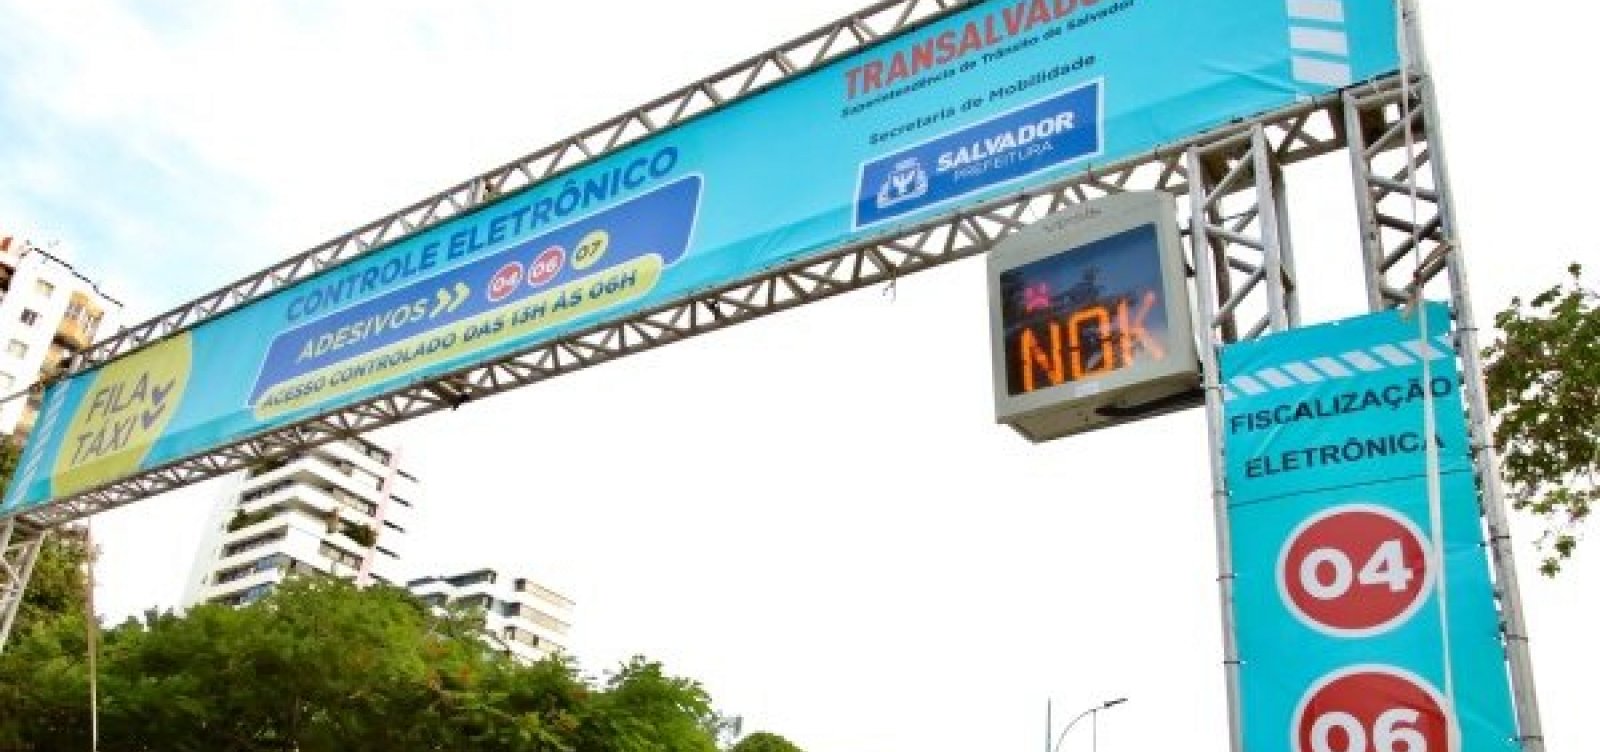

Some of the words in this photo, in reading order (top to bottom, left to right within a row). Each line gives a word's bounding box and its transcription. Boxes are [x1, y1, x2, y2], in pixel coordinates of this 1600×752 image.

[844, 0, 1099, 100] TRANSALVAD
[869, 107, 956, 145] Secretaria
[960, 98, 984, 113] de
[989, 54, 1096, 102] Mobilidade
[936, 111, 1075, 171] SALVADOR
[953, 141, 1054, 184] PREFEITURA
[286, 243, 438, 321] CONTROLE
[447, 146, 678, 260] ELETRÔNICO
[261, 376, 327, 409] ACESSO
[329, 332, 457, 387] CONTROLADO
[463, 317, 505, 343] DAS
[298, 298, 427, 364] ADESIVOS
[1020, 290, 1167, 393] NOK
[85, 370, 150, 425] FILA
[1230, 376, 1452, 435] FISCALIZAÇÃO
[1299, 538, 1415, 601] 04
[1310, 707, 1429, 752] 06
